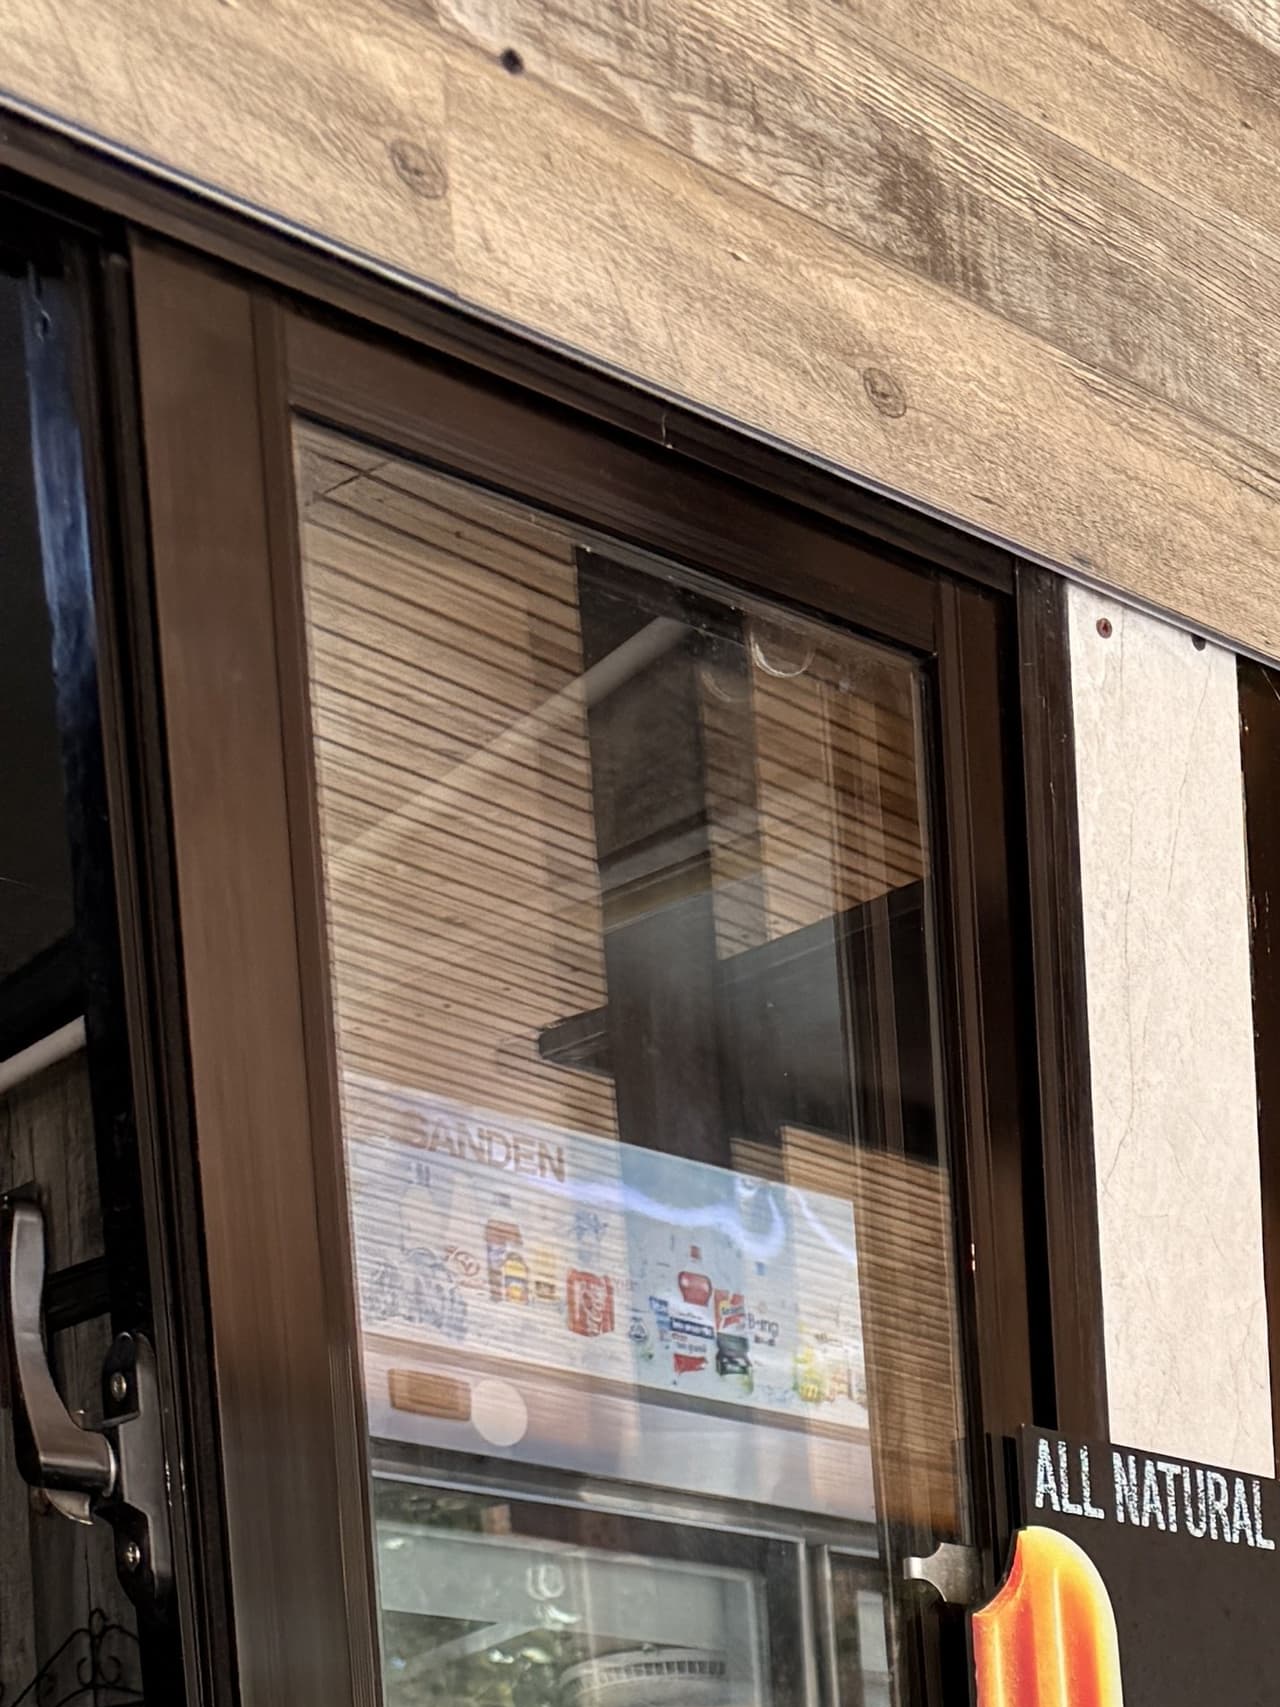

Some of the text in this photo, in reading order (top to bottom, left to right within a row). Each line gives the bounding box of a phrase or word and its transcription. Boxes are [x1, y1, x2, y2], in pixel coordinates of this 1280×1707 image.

[401, 1109, 567, 1184] SANDEN
[1034, 1438, 1105, 1519] ALL
[1112, 1452, 1275, 1550] NATURAL
